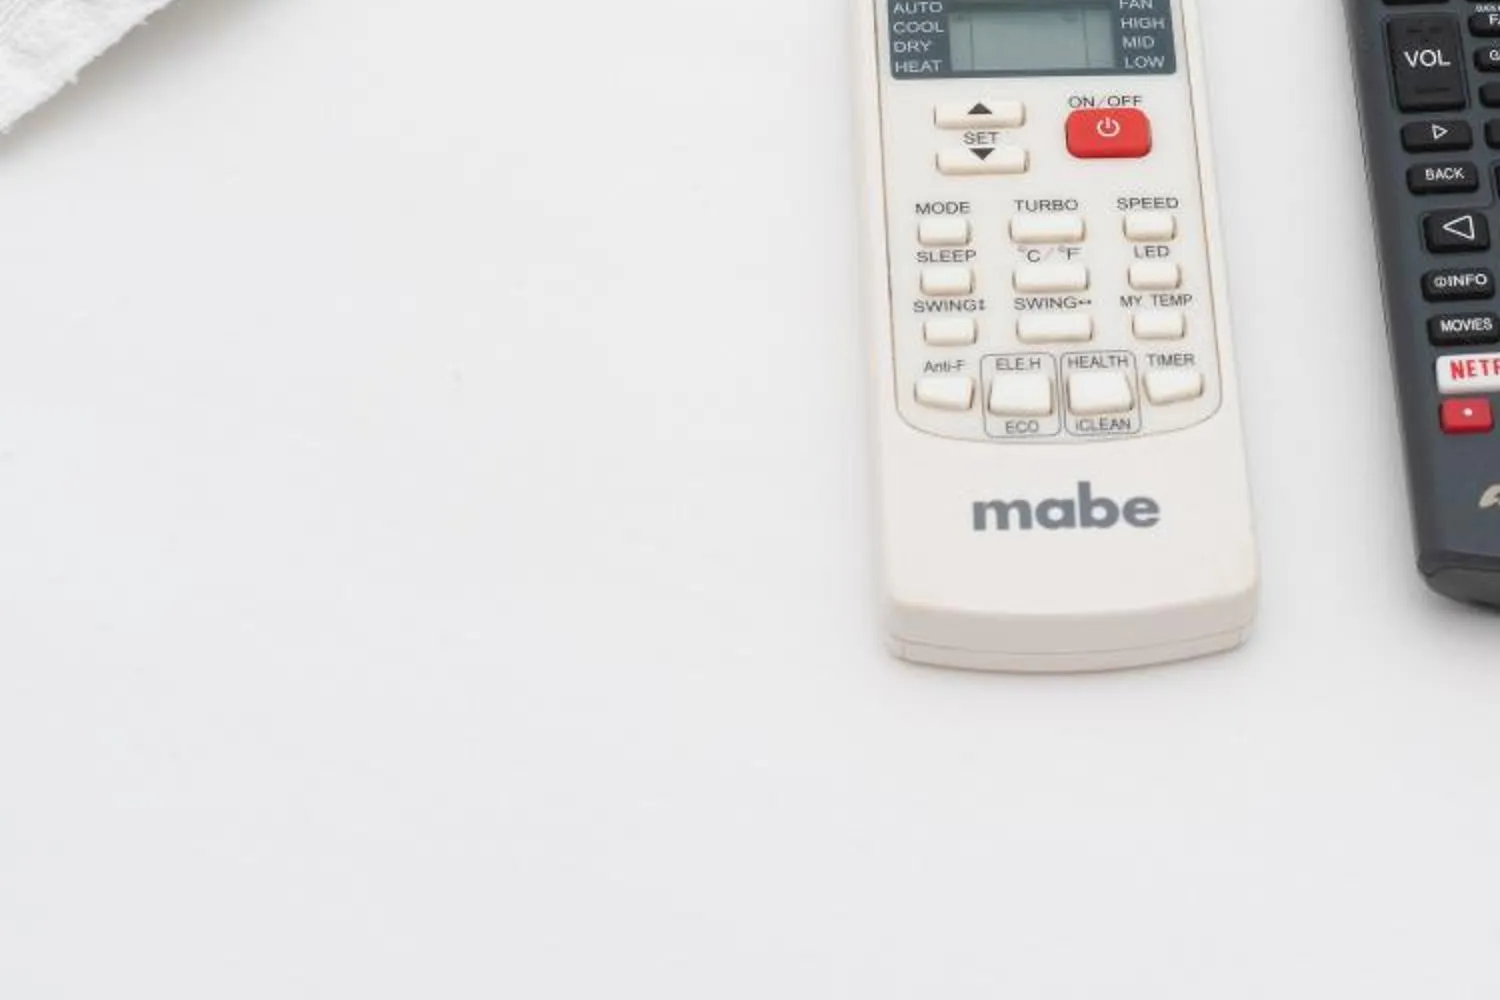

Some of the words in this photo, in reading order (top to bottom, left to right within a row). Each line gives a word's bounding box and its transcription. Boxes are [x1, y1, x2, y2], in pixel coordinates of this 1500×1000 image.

[893, 1, 943, 15] AUTO
[893, 21, 945, 34] COOL
[1120, 17, 1165, 31] HIGH
[893, 39, 932, 53] DRY
[1122, 36, 1155, 49] MID
[1124, 55, 1165, 69] LOW
[1404, 49, 1451, 68] VOL
[895, 59, 943, 73] HEAT
[963, 131, 999, 145] SET
[1425, 167, 1465, 181] BACK
[915, 202, 971, 215] MODE
[1014, 199, 1079, 211] TURBO
[1116, 197, 1179, 210] SPEED
[917, 250, 977, 263] SLEEP
[1133, 245, 1170, 258] LED
[1448, 274, 1488, 287] INFO
[913, 300, 978, 313] SWING
[1014, 297, 1078, 310] SWING
[1119, 294, 1143, 307] MY
[1150, 294, 1193, 307] TEMP
[1440, 318, 1493, 332] MOVIES
[924, 360, 967, 374] Anti-F
[1067, 355, 1129, 369] HEALTH
[1148, 353, 1196, 367] TIMER
[1005, 420, 1040, 434] ECO
[1075, 417, 1132, 432] iCLEAN
[972, 481, 1161, 531] mabe
